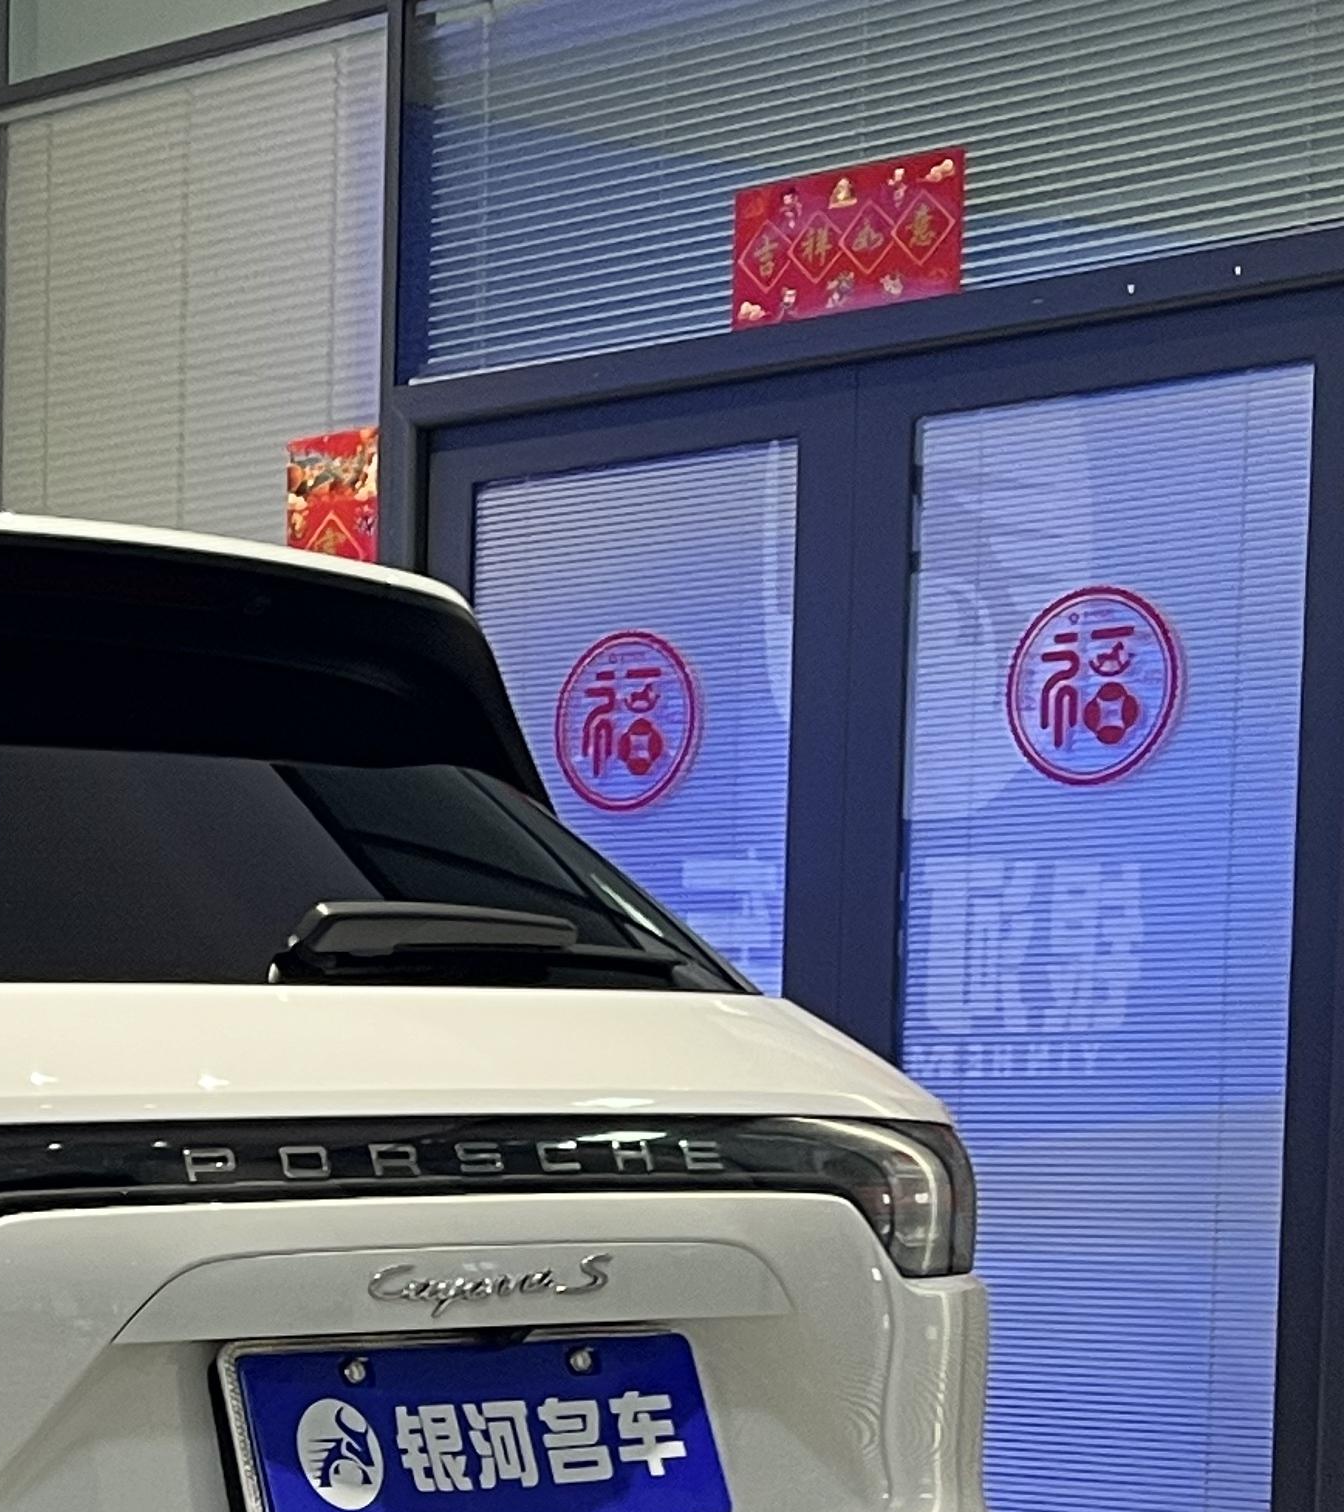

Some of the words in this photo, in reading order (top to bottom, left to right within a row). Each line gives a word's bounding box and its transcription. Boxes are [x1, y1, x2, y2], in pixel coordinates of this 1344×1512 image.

[753, 203, 938, 279] 吉祥如意
[182, 1138, 724, 1183] PORSCHE
[367, 1262, 555, 1320] Cayenne
[555, 1252, 614, 1296] S
[394, 1390, 688, 1493] 银河名车
